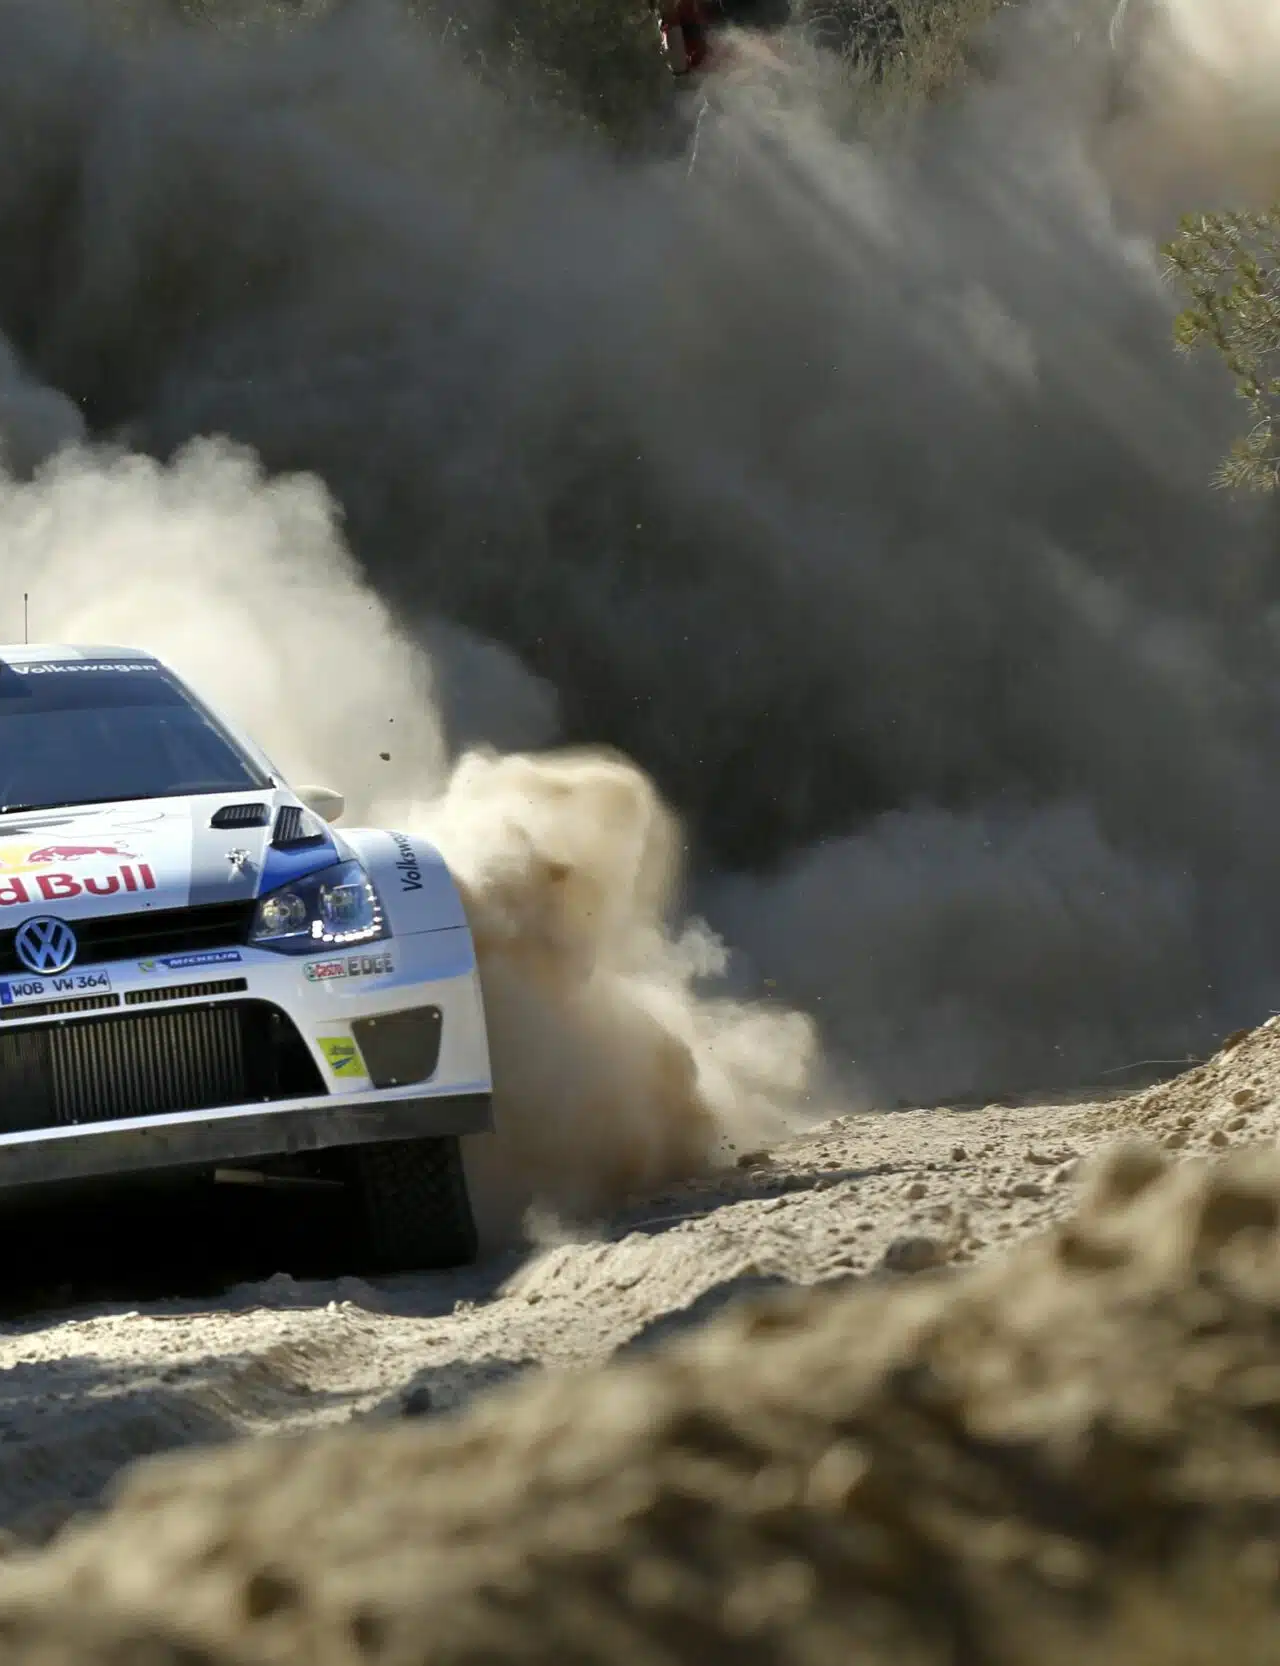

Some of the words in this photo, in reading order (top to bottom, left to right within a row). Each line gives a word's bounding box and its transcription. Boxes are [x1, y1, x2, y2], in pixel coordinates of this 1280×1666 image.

[11, 663, 158, 675] Volkswagen
[35, 864, 156, 901] Bull
[169, 953, 238, 966] MICHELIN
[347, 953, 395, 976] EDGE
[12, 982, 44, 997] WOB
[52, 977, 74, 992] VW
[77, 974, 107, 989] 364
